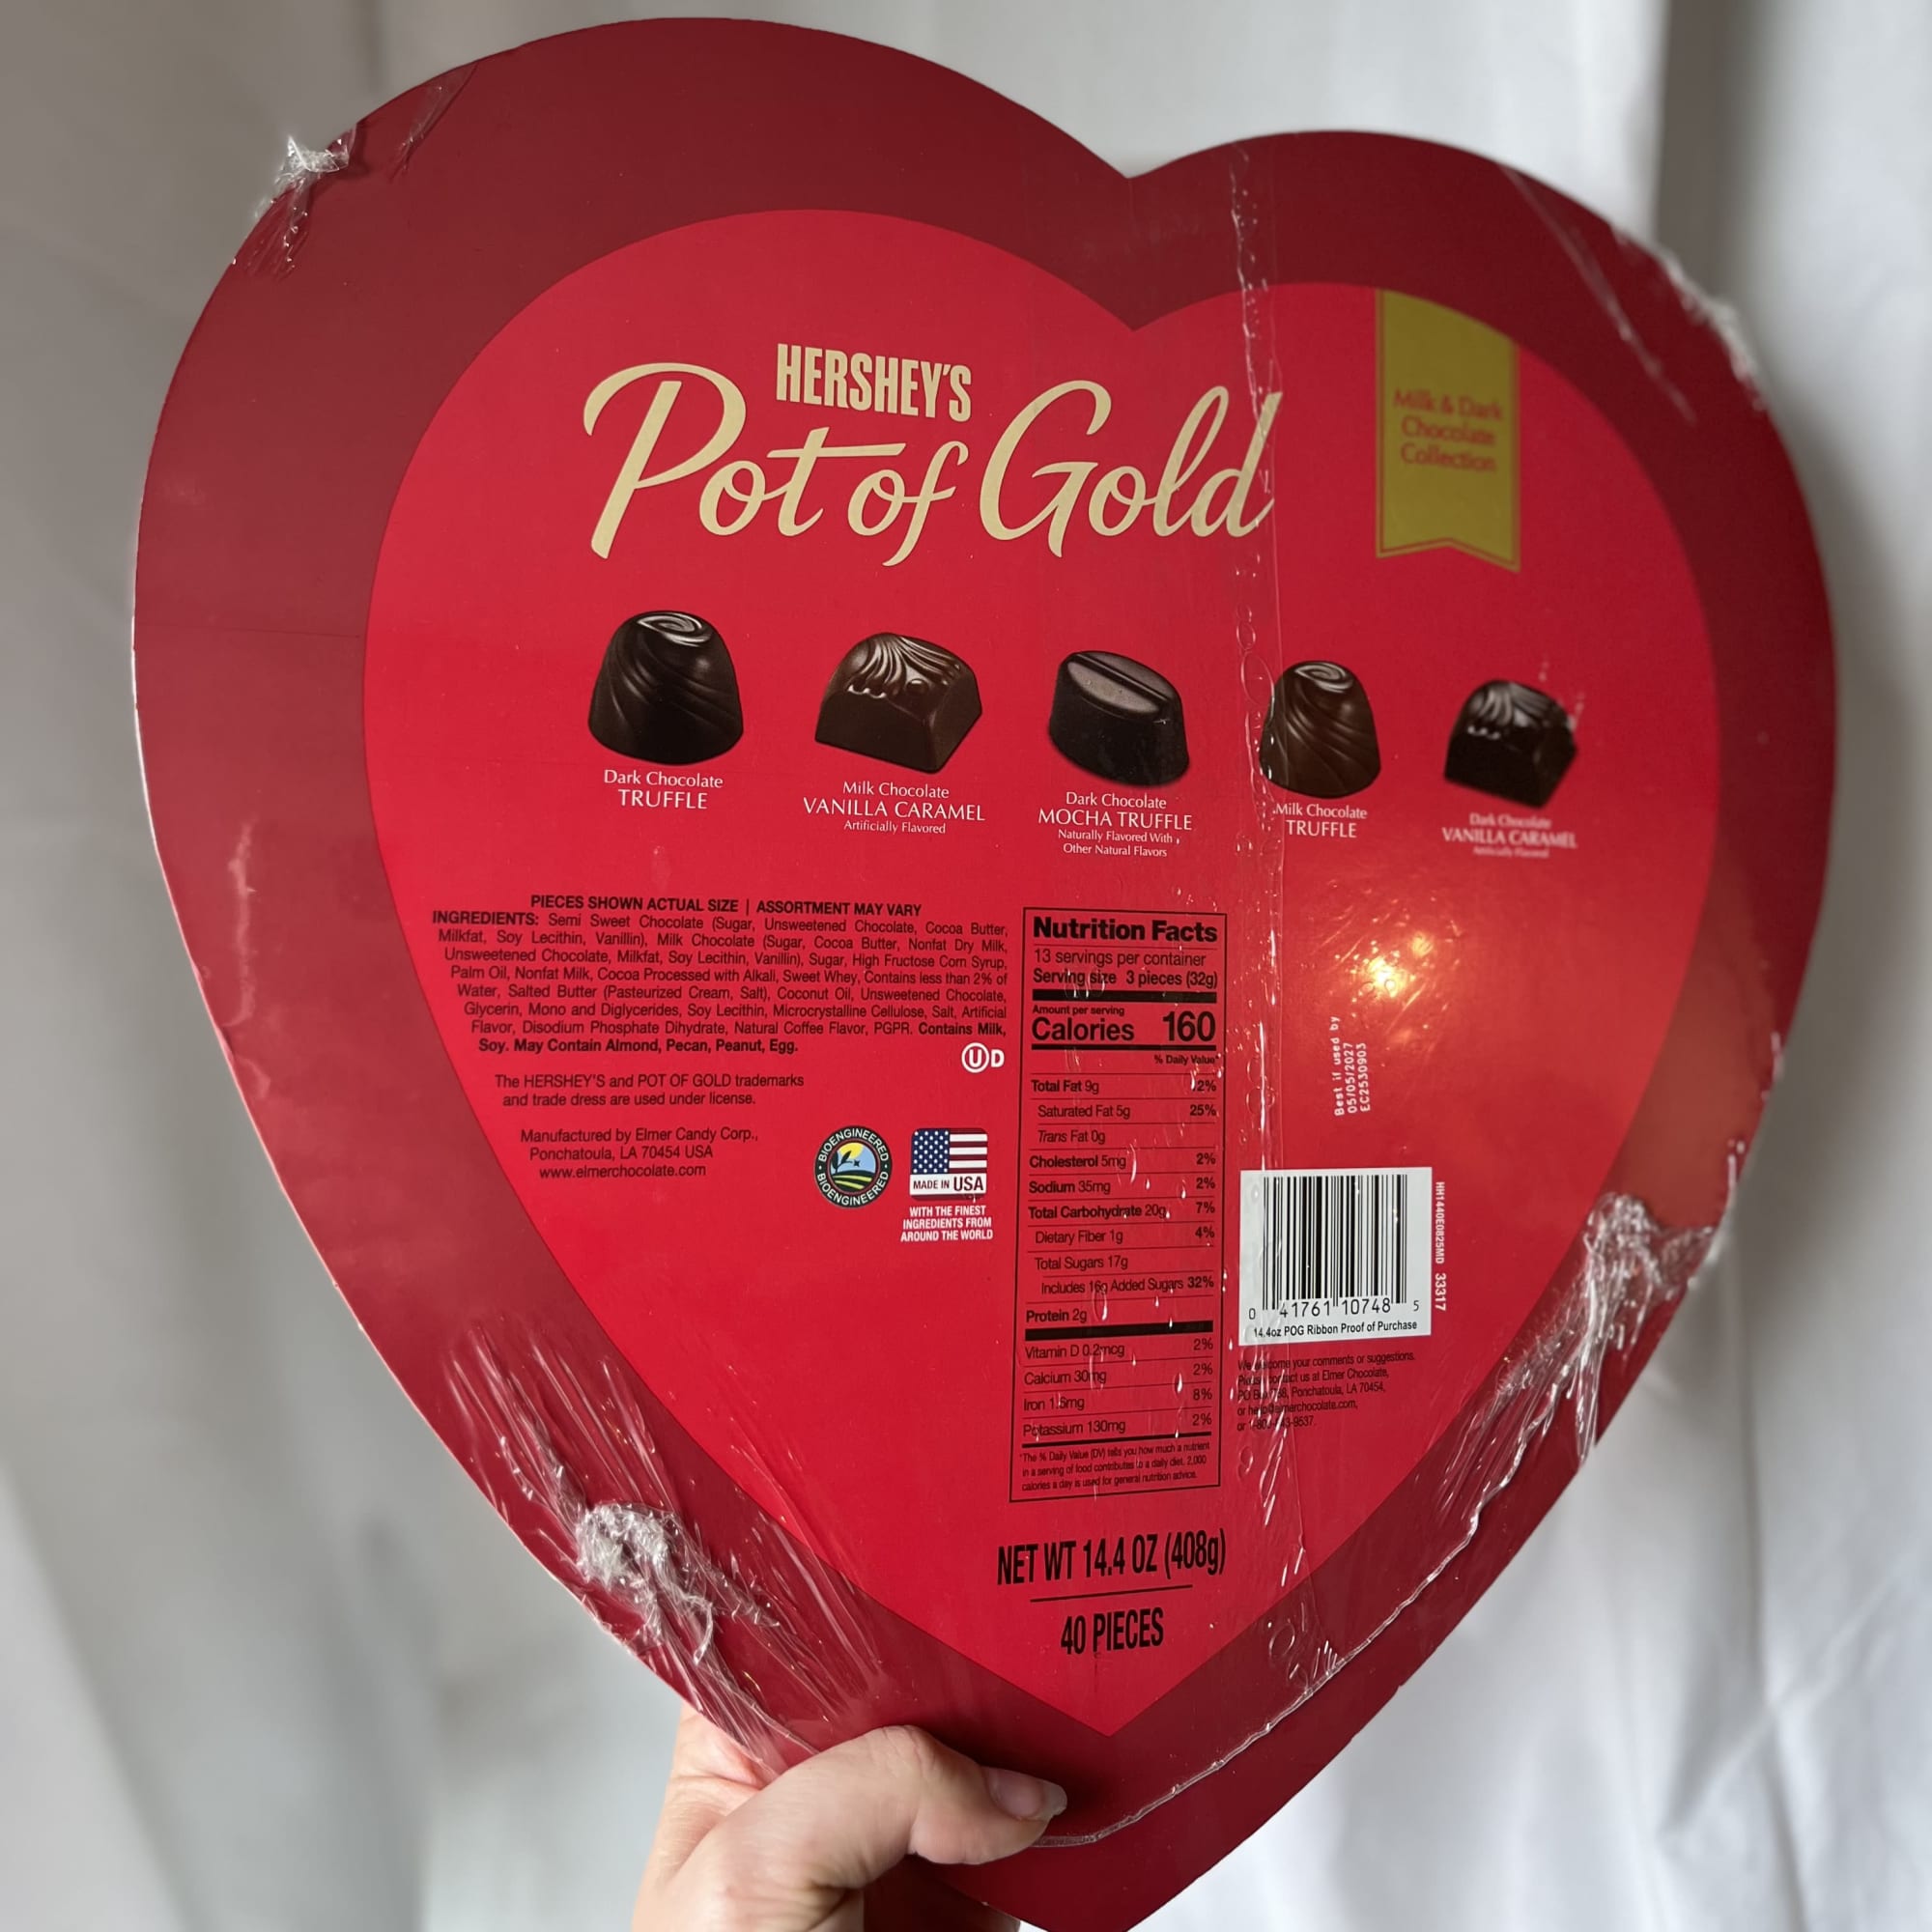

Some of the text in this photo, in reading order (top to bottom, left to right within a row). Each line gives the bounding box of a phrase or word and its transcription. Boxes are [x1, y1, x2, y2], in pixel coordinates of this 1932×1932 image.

[776, 342, 971, 422] HERSHEY'S
[1401, 415, 1496, 445] Chocolate
[582, 362, 1283, 566] Pot of Gold
[1401, 442, 1496, 472] Collection
[604, 769, 723, 788] Dark Chocolate
[617, 788, 707, 809] TRUFFLE
[842, 781, 950, 798] Milk Chocolate
[803, 797, 985, 820] VANILLA CARAMEL
[1065, 791, 1167, 810] Dark Chocolate
[1037, 808, 1192, 830] MOCHA TRUFFLE
[1275, 802, 1368, 819] Milk Chocolate
[843, 819, 946, 834] Artificially Flavored
[1285, 819, 1356, 838] TRUFFLE
[1469, 812, 1551, 830] Dark Chocolate
[1058, 829, 1173, 843] Naturally Flavored With
[1441, 827, 1576, 847] VANILLA CARAMEL
[1063, 840, 1167, 857] Other Natural Flavors
[530, 895, 922, 916] PIECES SHOWN ACTUAL SIZE ASSORTMENT MAY VARY
[432, 910, 1008, 937] INGREDIENTS: Semi Sweet Chocolate (Sugar, Unsweetened Chocolate, Cocoa Butter,
[1034, 917, 1217, 943] Nutrition Facts
[1034, 948, 1207, 970] 13 servings per container
[1033, 967, 1217, 989] Serving size 3 pieces (32g)
[1032, 1004, 1124, 1017] Amount per serving
[1032, 1010, 1215, 1041] Calories 160
[478, 1037, 798, 1055] Soy. May Contain Almond, Pecan, Peanut, Egg.
[1329, 1016, 1345, 1116] Best if used by
[494, 1073, 804, 1088] The HERSHEY'S and POT OF GOLD trademarks
[1031, 1079, 1099, 1094] Total Fat 9g
[1343, 1042, 1357, 1114] 05/05/2027
[1355, 1042, 1371, 1112] EC2530903
[502, 1092, 755, 1107] and trade dress are used under license.
[1037, 1103, 1216, 1120] Saturated Fat 5g 25%
[520, 1125, 757, 1145] Manufactured by Elmer Candy Corp.,
[529, 1145, 713, 1161] Ponchatoula, LA 70454 USA
[817, 1127, 890, 1163] BIOENGINEERED
[1029, 1152, 1216, 1170] Cholesterol 5mg 2%
[539, 1164, 706, 1179] www.elmerchocolate.com
[816, 1170, 890, 1207] BIOENGINEERED
[913, 1176, 984, 1192] MADE IN USA
[909, 1205, 986, 1217] WITH THE FINEST
[902, 1216, 991, 1230] INGREDIENTS FROM
[900, 1229, 993, 1241] AROUND THE WORLD
[1035, 1226, 1215, 1245] Dietary Fiber 1g 4%
[1026, 1308, 1087, 1323] Protein 2g
[1248, 1297, 1420, 1320] 0 41761 10748 5
[1253, 1320, 1417, 1337] 14.4oz POG Ribbon Proof of Purchase
[1022, 1412, 1212, 1437] Potassium 130mg 2%
[997, 1528, 1226, 1584] NET WT 14.4 OZ (408g)
[1060, 1606, 1164, 1654] 40 PIECES
